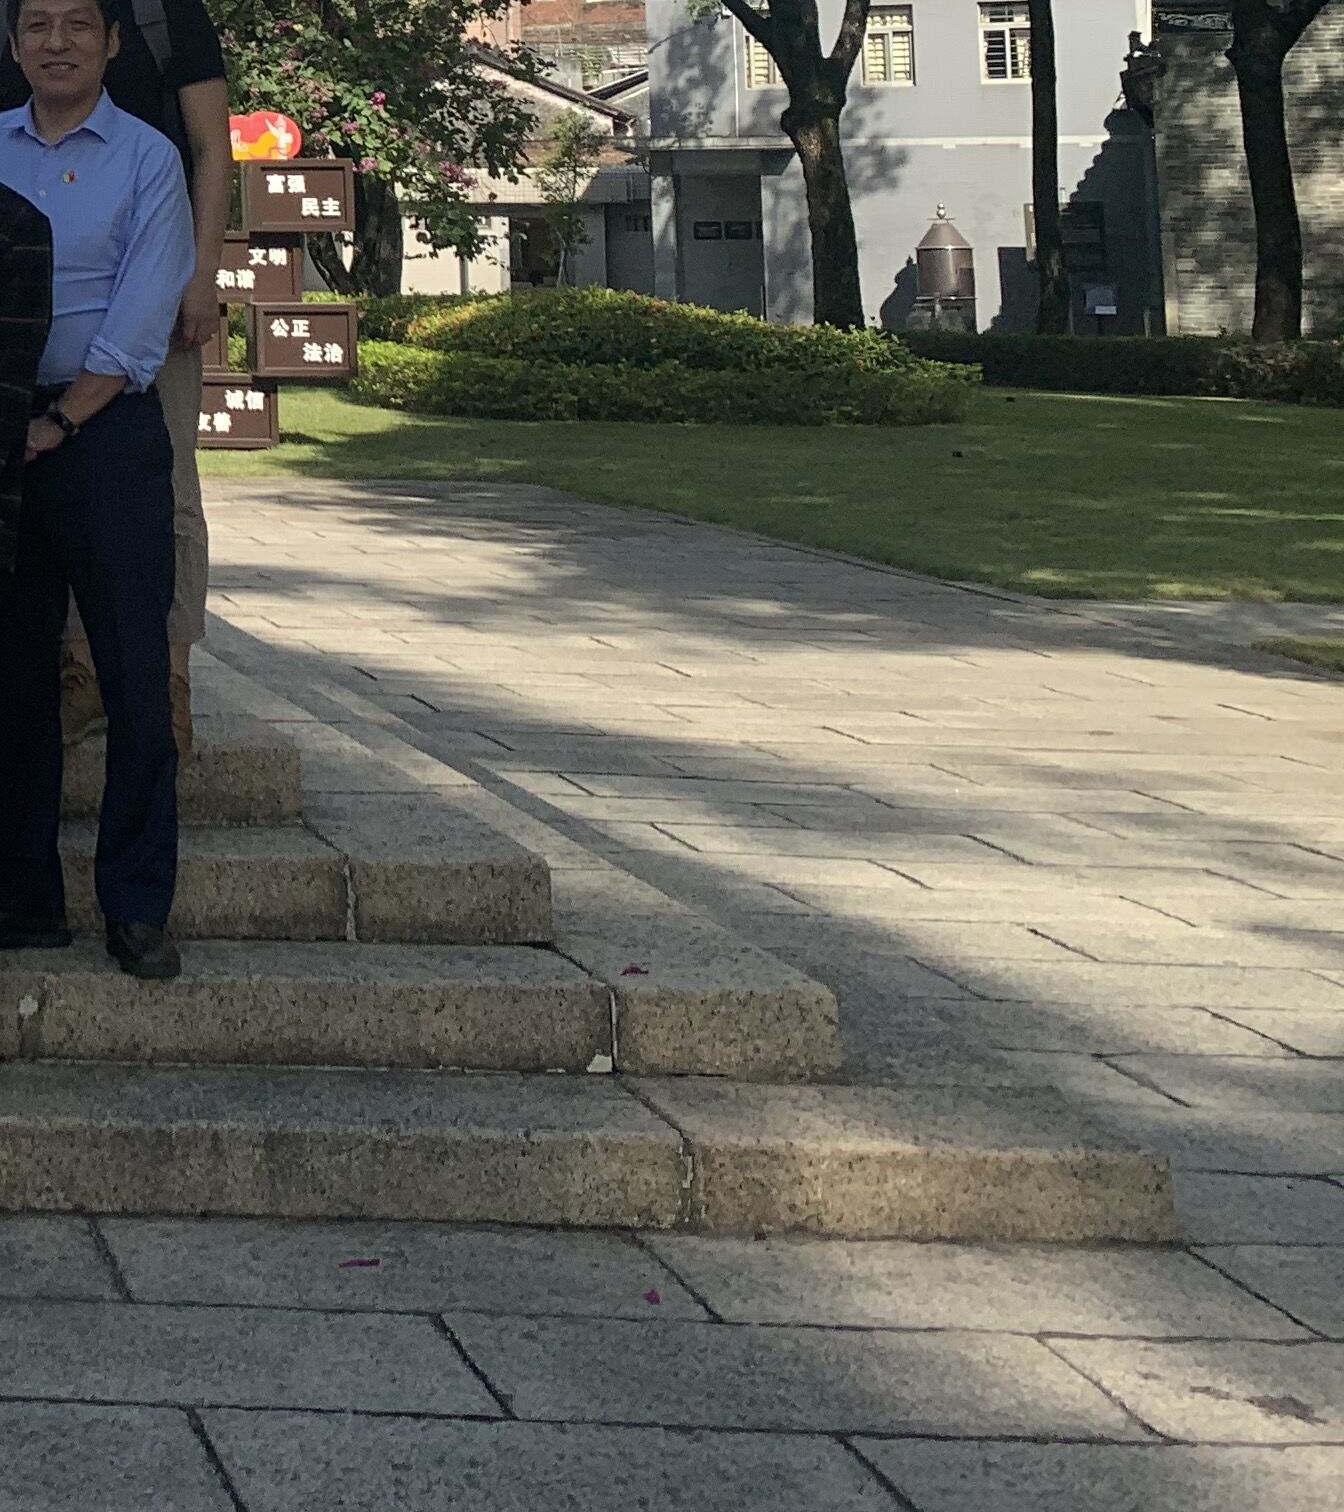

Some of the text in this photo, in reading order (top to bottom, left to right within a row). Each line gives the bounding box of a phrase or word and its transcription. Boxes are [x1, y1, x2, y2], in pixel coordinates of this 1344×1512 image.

[266, 174, 306, 194] 富强
[301, 197, 341, 217] 民主
[248, 248, 287, 266] 文明
[216, 269, 255, 289] 和谐
[270, 318, 311, 338] 公正
[302, 343, 344, 363] 法治
[224, 389, 265, 411] 诚信
